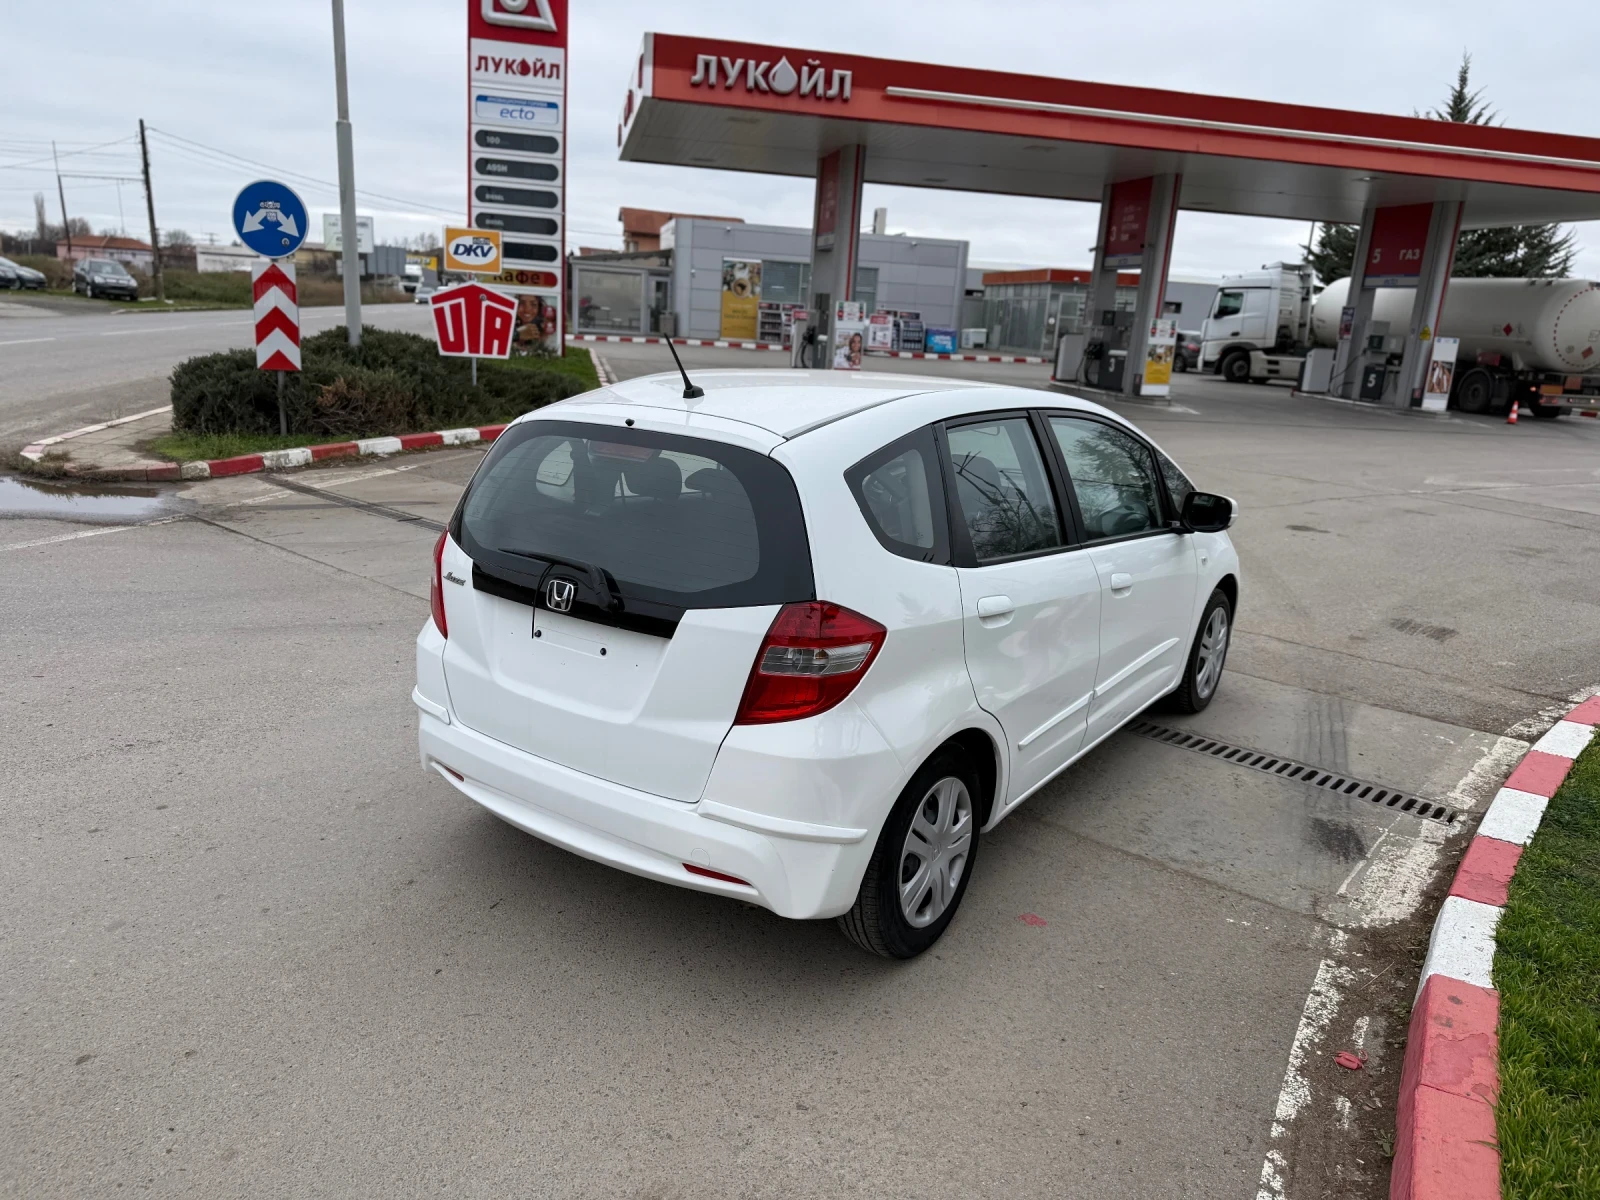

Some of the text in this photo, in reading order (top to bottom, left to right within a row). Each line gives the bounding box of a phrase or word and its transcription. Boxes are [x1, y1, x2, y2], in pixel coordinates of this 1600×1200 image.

[475, 55, 560, 79] ЛУКОЙЛ
[691, 54, 853, 100] ЛУКОЙЛ
[500, 107, 535, 120] ecto
[486, 136, 501, 145] 100
[453, 243, 494, 258] DKV
[1371, 248, 1382, 264] 5
[1399, 248, 1421, 261] ГАЗ
[433, 283, 514, 356] UTA
[1367, 373, 1377, 388] 5
